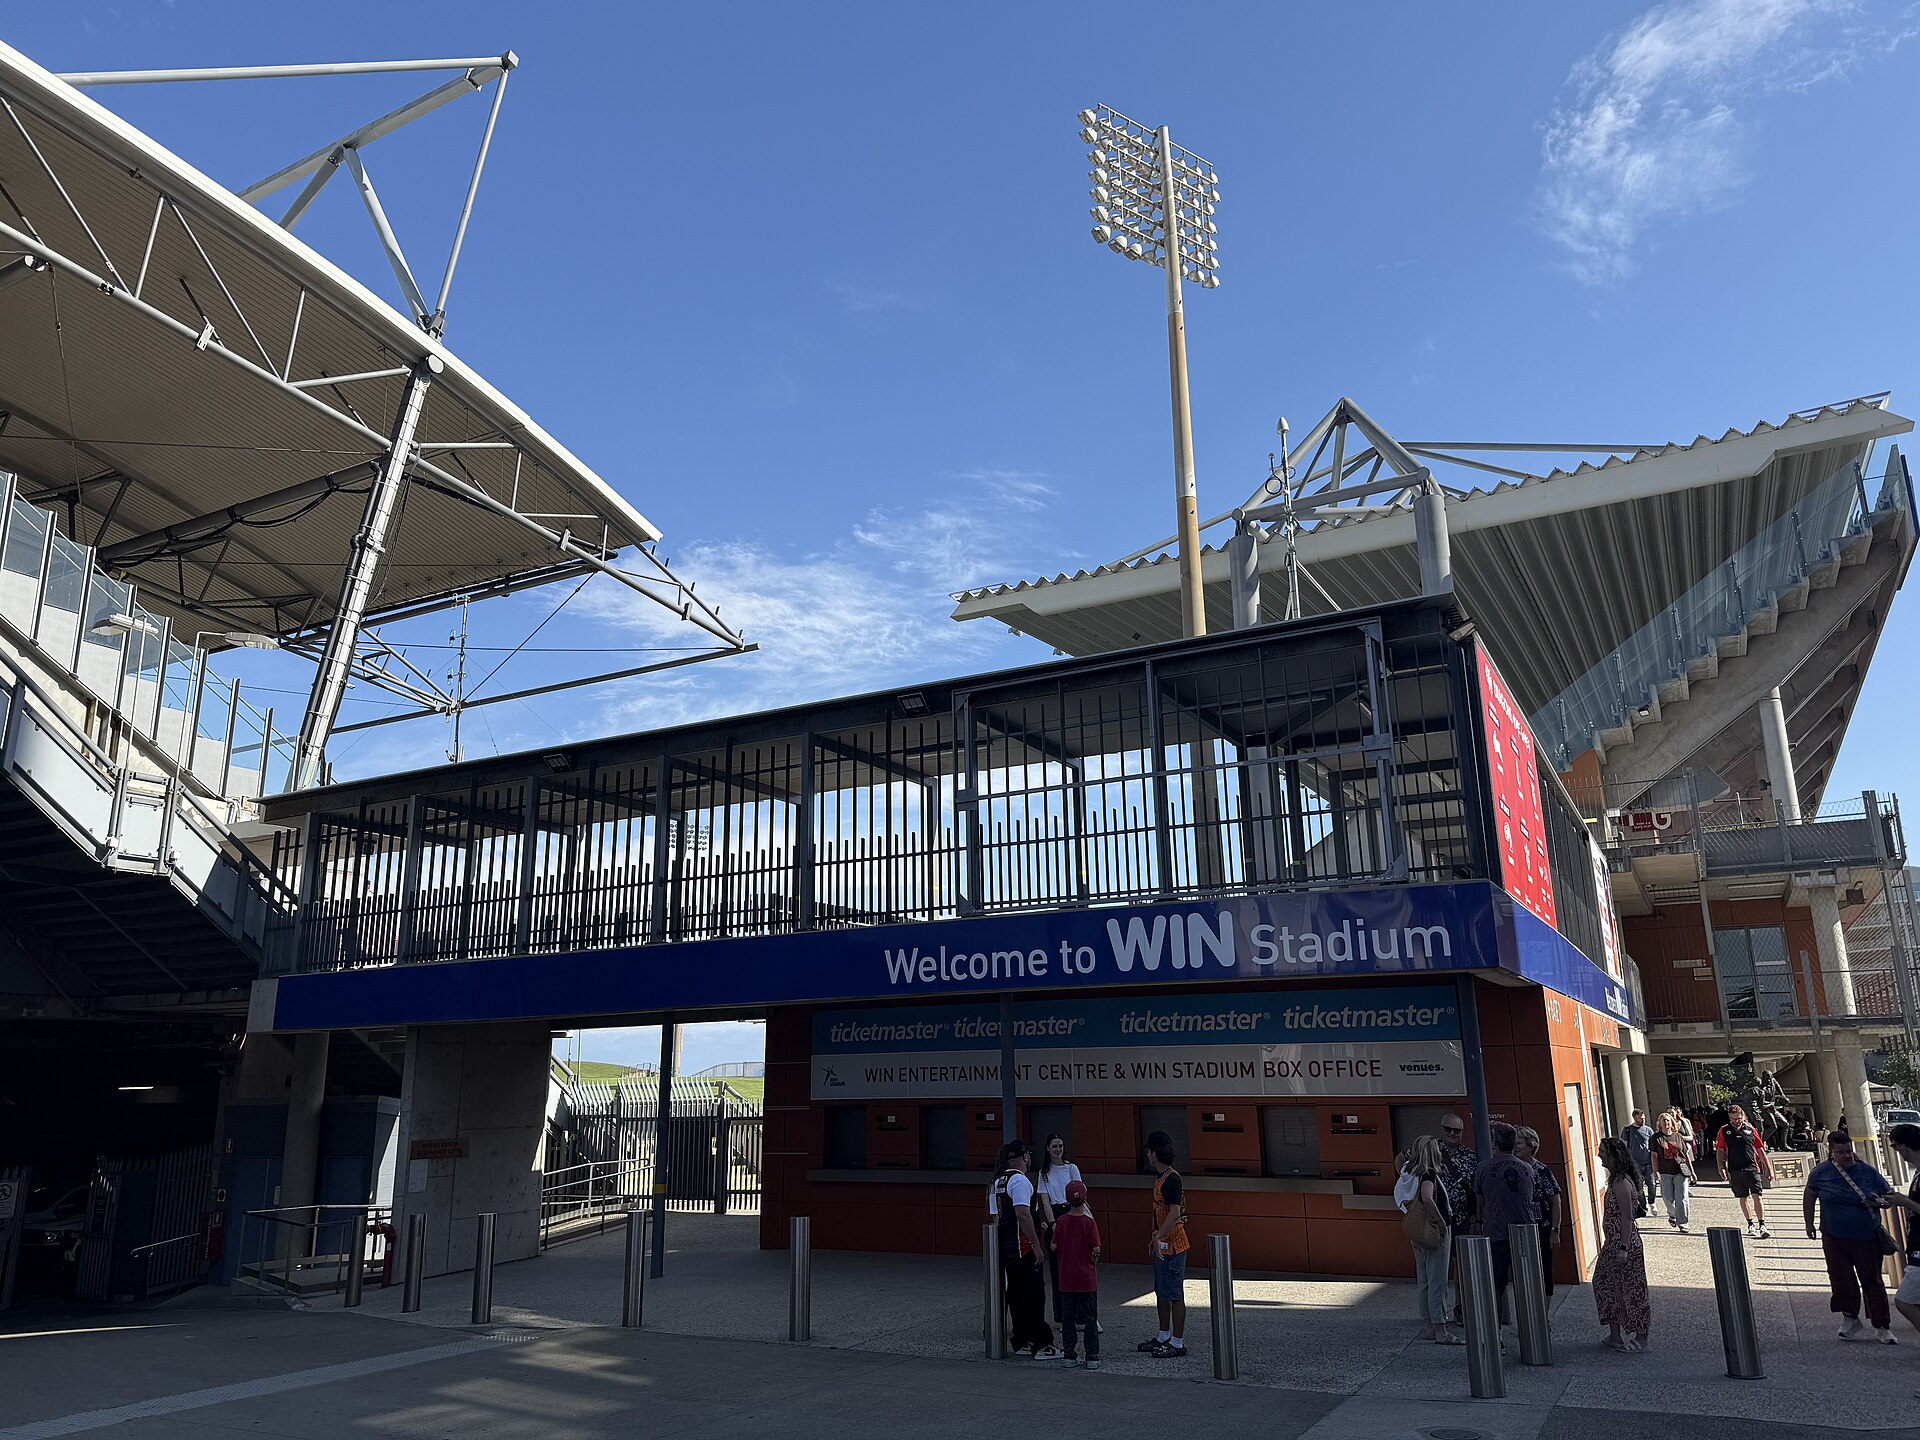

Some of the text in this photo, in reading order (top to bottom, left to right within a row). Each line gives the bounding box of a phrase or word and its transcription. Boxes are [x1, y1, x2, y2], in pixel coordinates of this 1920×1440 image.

[885, 910, 1452, 984] Welcome to WIN Stadium
[865, 1059, 1383, 1083] WIN ENTERTAINMNT CENTRE & WIN STADIUM BOX OFFICE
